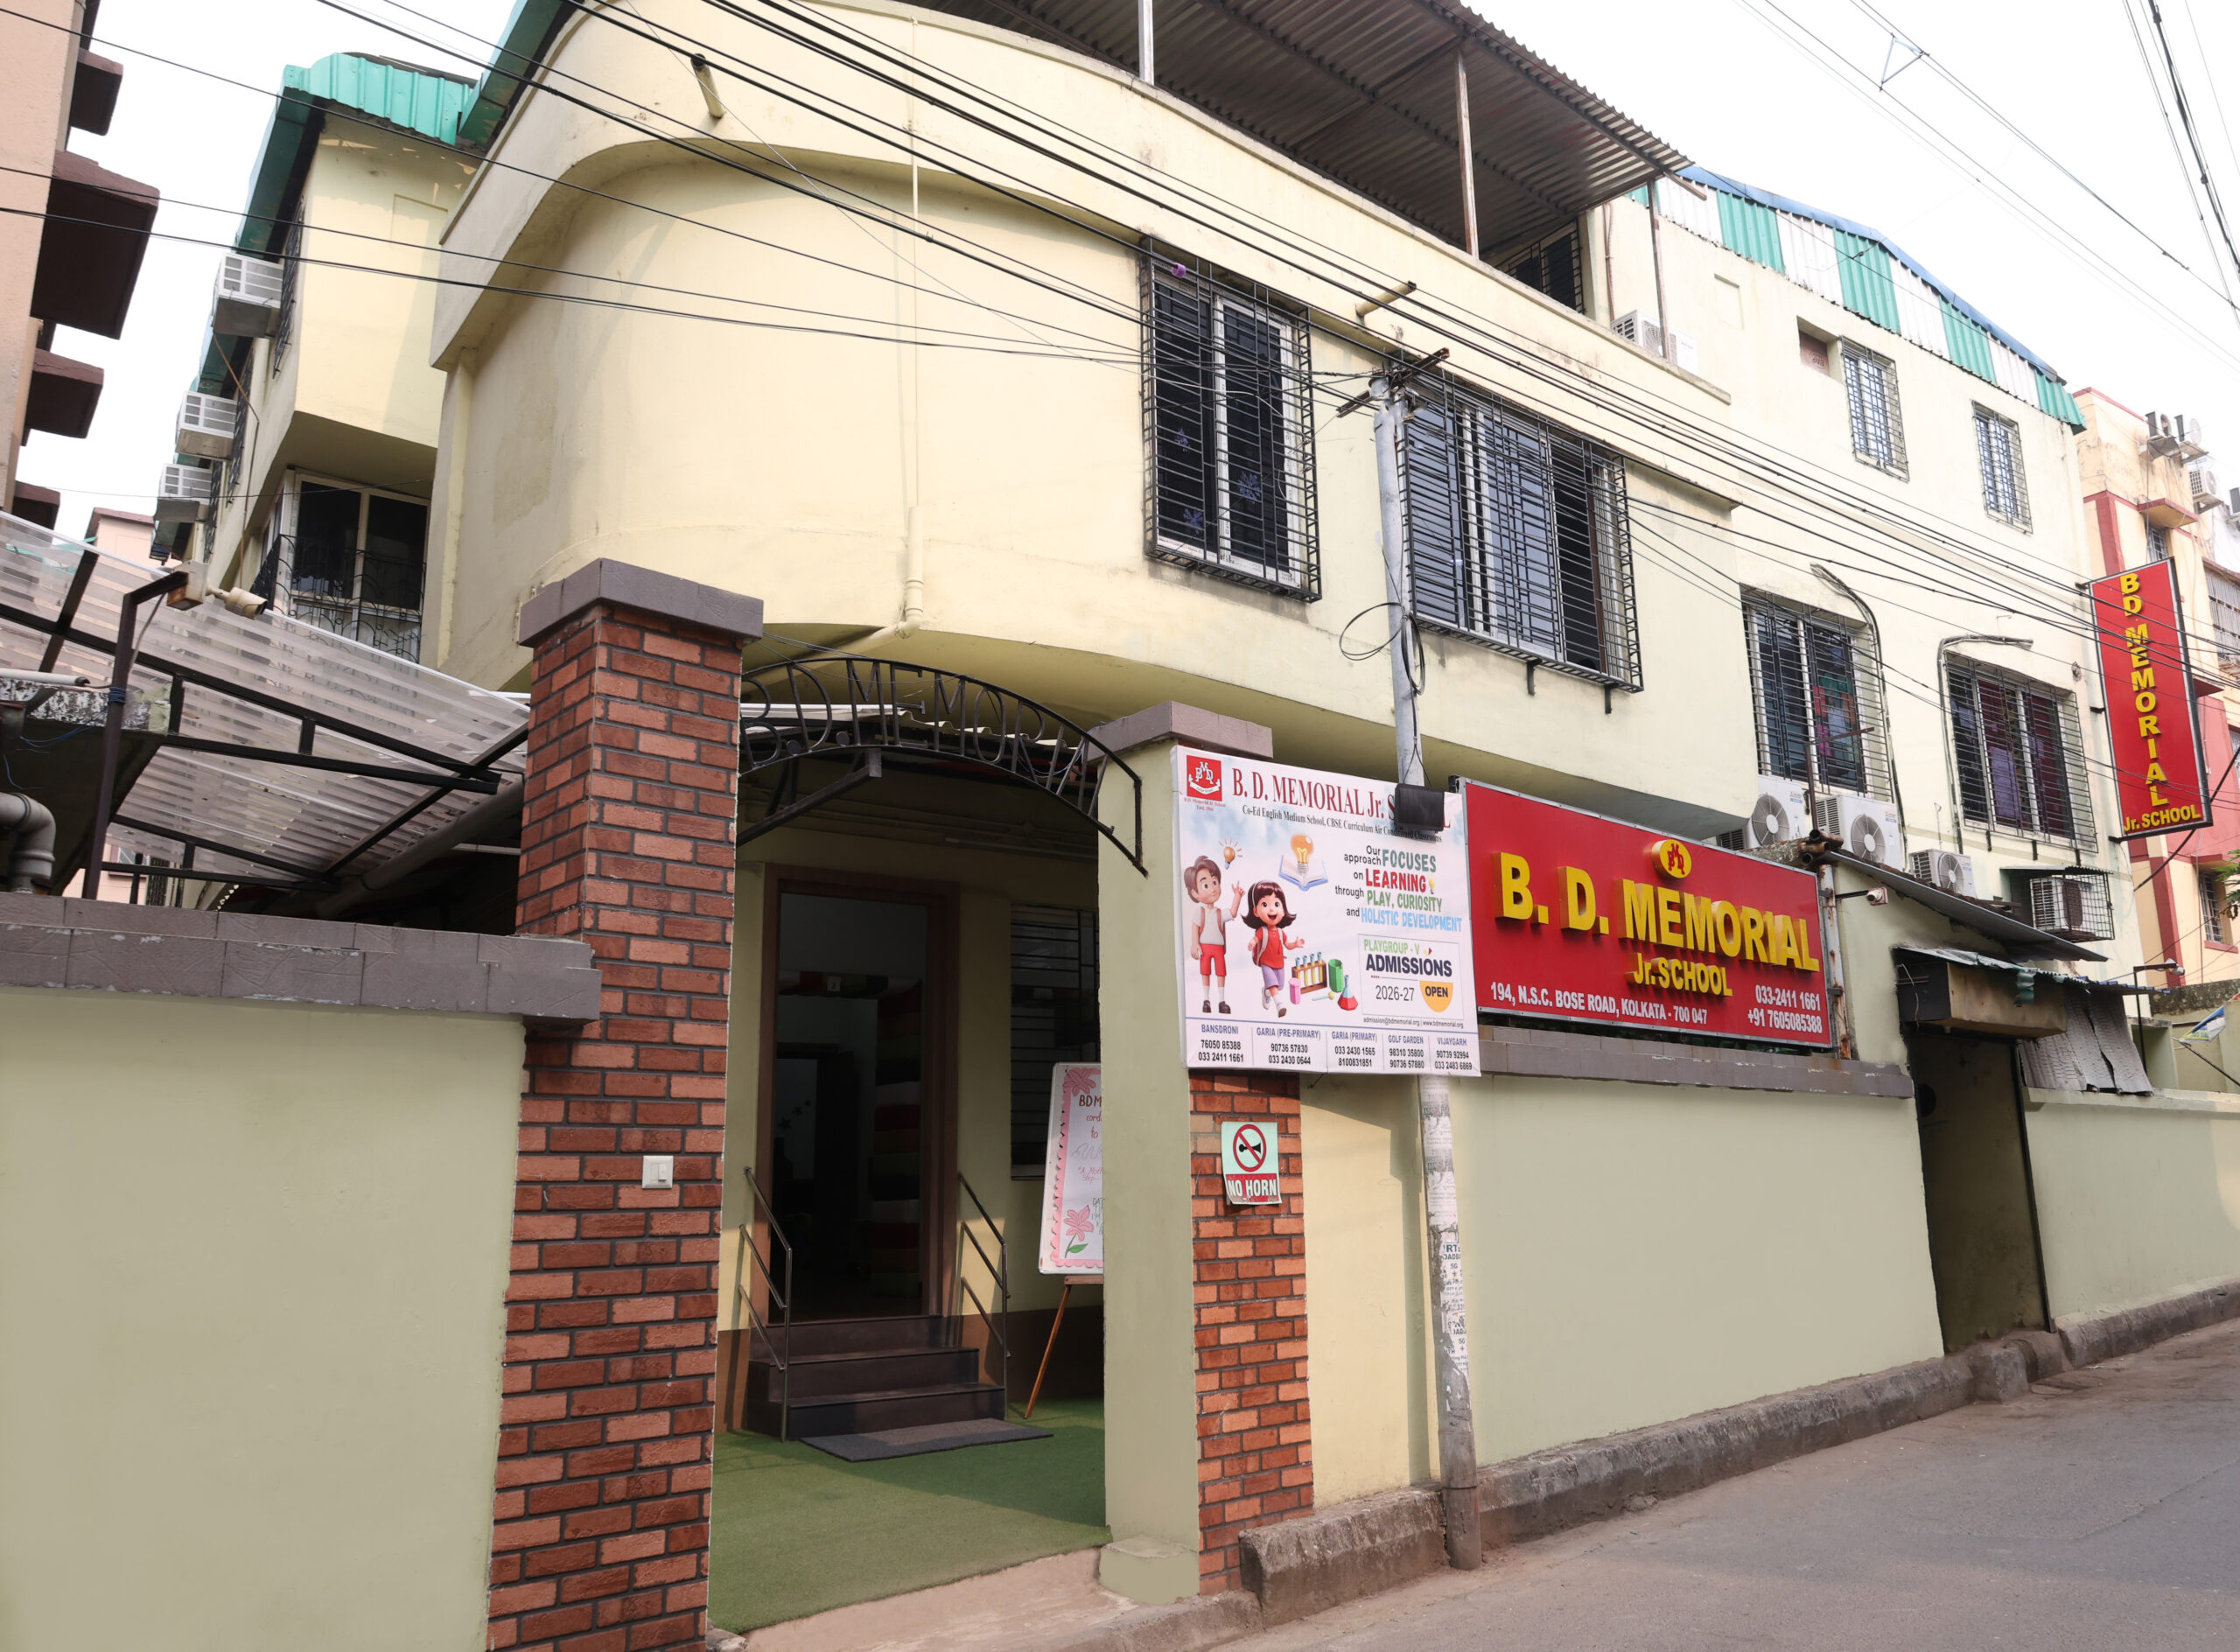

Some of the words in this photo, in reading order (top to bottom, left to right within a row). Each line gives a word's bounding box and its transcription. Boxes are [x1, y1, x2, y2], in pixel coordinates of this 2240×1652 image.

[2125, 623, 2169, 807] MEMORIAL
[1232, 768, 1248, 797] B.
[1252, 771, 1268, 801] D.
[1272, 775, 1364, 816] MEMORIAL
[1367, 791, 1384, 819] Jr.
[1242, 805, 1261, 816] Co-Ed
[1262, 808, 1282, 821] English
[1283, 811, 1306, 823] Medium
[1306, 815, 1326, 827] School,
[1326, 817, 1342, 829] CBSE
[1343, 821, 1373, 833] Curriculum
[1374, 824, 1382, 835] Air
[2124, 816, 2140, 831] Jr.
[2142, 804, 2202, 828] SCHOOL
[1366, 845, 1381, 856] Our
[1344, 854, 1382, 865] approach
[1382, 849, 1437, 872] FOCUSES
[1354, 872, 1363, 880] on
[1366, 868, 1426, 893] LEARNING
[1335, 886, 1364, 900] through
[1367, 890, 1395, 908] PLAY,
[1397, 892, 1442, 913] CURIOSITY
[1493, 852, 1549, 924] B.
[1558, 866, 1609, 934] D.
[1619, 878, 1820, 971] MEMORIAL
[1347, 907, 1360, 917] and
[1362, 907, 1399, 926] HOLISTIC
[1402, 912, 1462, 932] DEVELOPMENT
[1364, 939, 1408, 954] PLAYGROUP
[1414, 943, 1420, 956] V
[1366, 954, 1452, 976] ADMISSIONS
[1629, 953, 1656, 984] Jr.
[1656, 956, 1732, 996] SCHOOL
[1376, 984, 1415, 1001] 2026-27
[1424, 986, 1449, 998] OPEN
[1755, 985, 1797, 1008] 033-2411
[1800, 991, 1821, 1012] 1661
[1491, 981, 1516, 1006] 194,
[1518, 985, 1552, 1007] N.S.C.
[1555, 990, 1585, 1011] BOSE
[1587, 994, 1620, 1018] ROAD,
[1621, 998, 1666, 1019] KOLKATA
[1673, 1006, 1690, 1023] 700
[1692, 1008, 1707, 1025] 047
[1423, 1020, 1464, 1029] www.bdmemorial.org
[1748, 1008, 1766, 1027] +91
[1768, 1010, 1823, 1033] 7605085388
[1201, 1024, 1239, 1034] BANSDRONI
[1256, 1027, 1276, 1037] GARIA
[1278, 1028, 1320, 1040] (PRE-PRIMARY)
[1332, 1031, 1348, 1040] GARIA
[1350, 1032, 1377, 1043] (PRIMARY)
[1388, 1034, 1401, 1043] GOLF
[1403, 1035, 1424, 1045] GARDEN
[1437, 1037, 1466, 1046] VIJAYGARH
[1200, 1040, 1220, 1049] 76050
[1222, 1040, 1241, 1051] 85388
[1270, 1043, 1289, 1053] 90736
[1334, 1046, 1346, 1054] 033
[1347, 1046, 1361, 1055] 2430
[1362, 1046, 1376, 1056] 1565
[1389, 1048, 1406, 1057] 98310
[1407, 1049, 1424, 1058] 35800
[1198, 1052, 1210, 1061] 033
[1212, 1053, 1227, 1062] 2411
[1229, 1054, 1243, 1062] 1661
[1268, 1054, 1279, 1064] 033
[1281, 1055, 1295, 1064] 2430
[1297, 1056, 1311, 1065] 0644
[1437, 1050, 1452, 1059] 90739
[1390, 1060, 1406, 1068] 90736
[1090, 1126, 1099, 1138] to
[1228, 1180, 1242, 1197] NO
[1245, 1180, 1277, 1197] HORN
